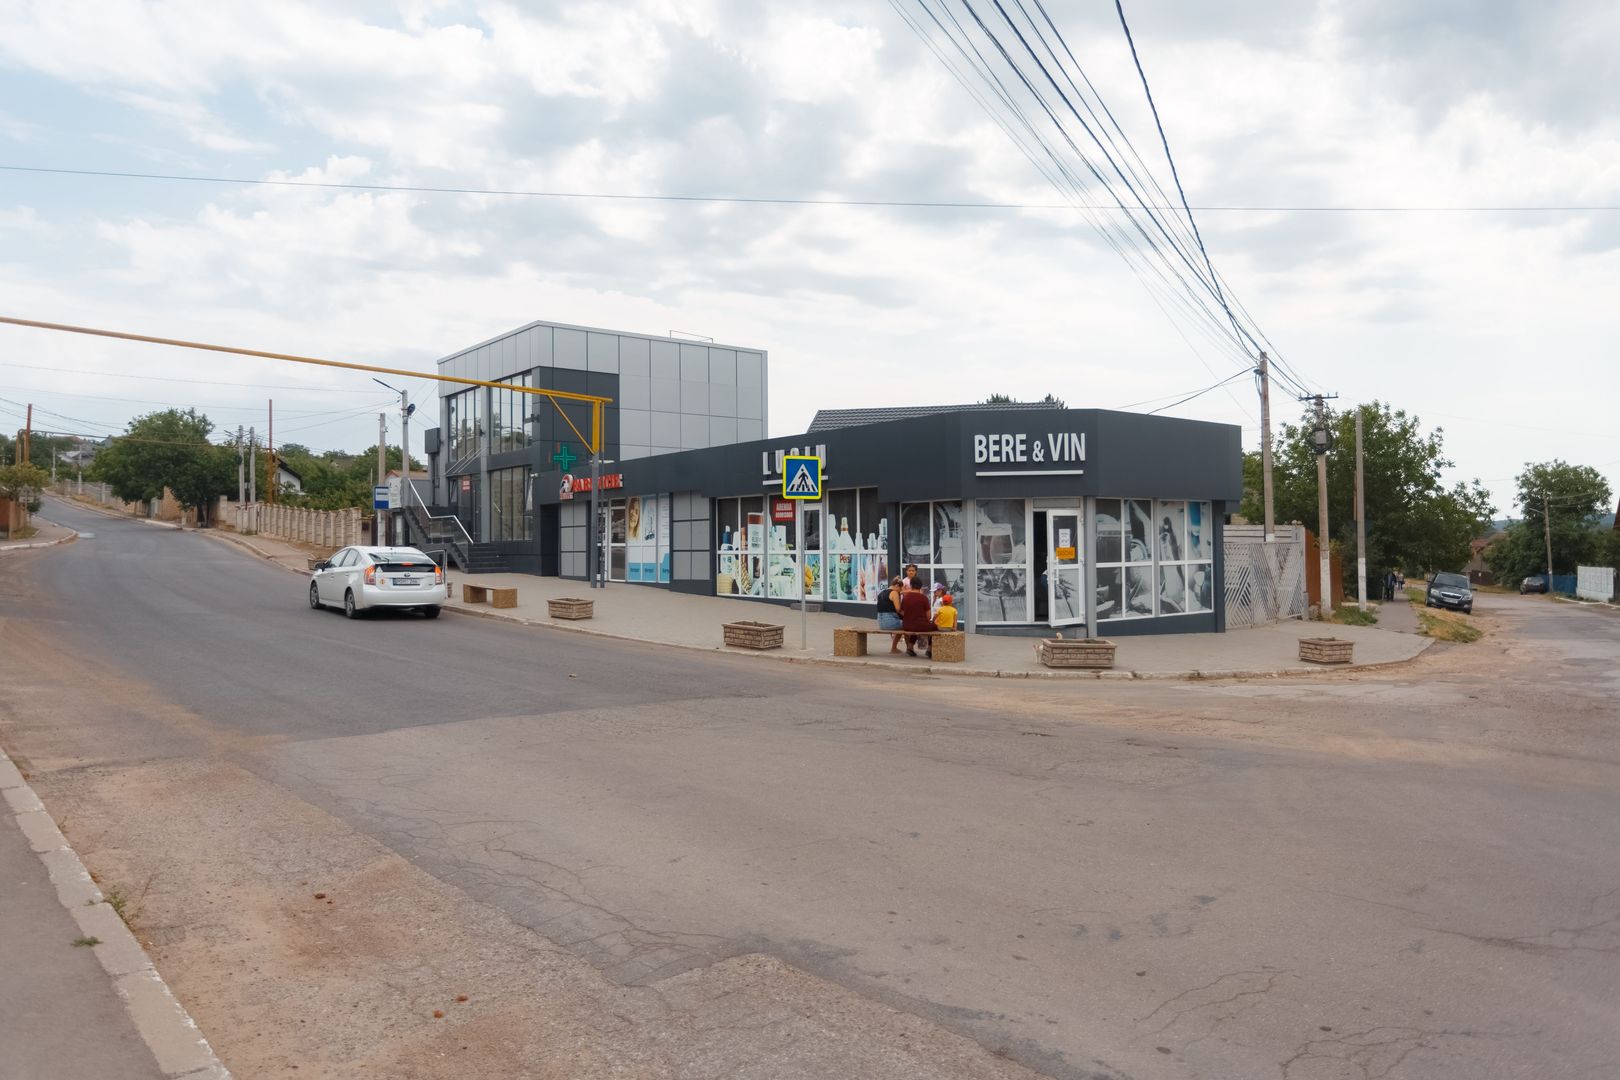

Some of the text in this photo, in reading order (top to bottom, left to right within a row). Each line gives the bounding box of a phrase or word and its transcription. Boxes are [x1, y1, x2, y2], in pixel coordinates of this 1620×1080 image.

[974, 432, 1086, 463] BERE & VIN
